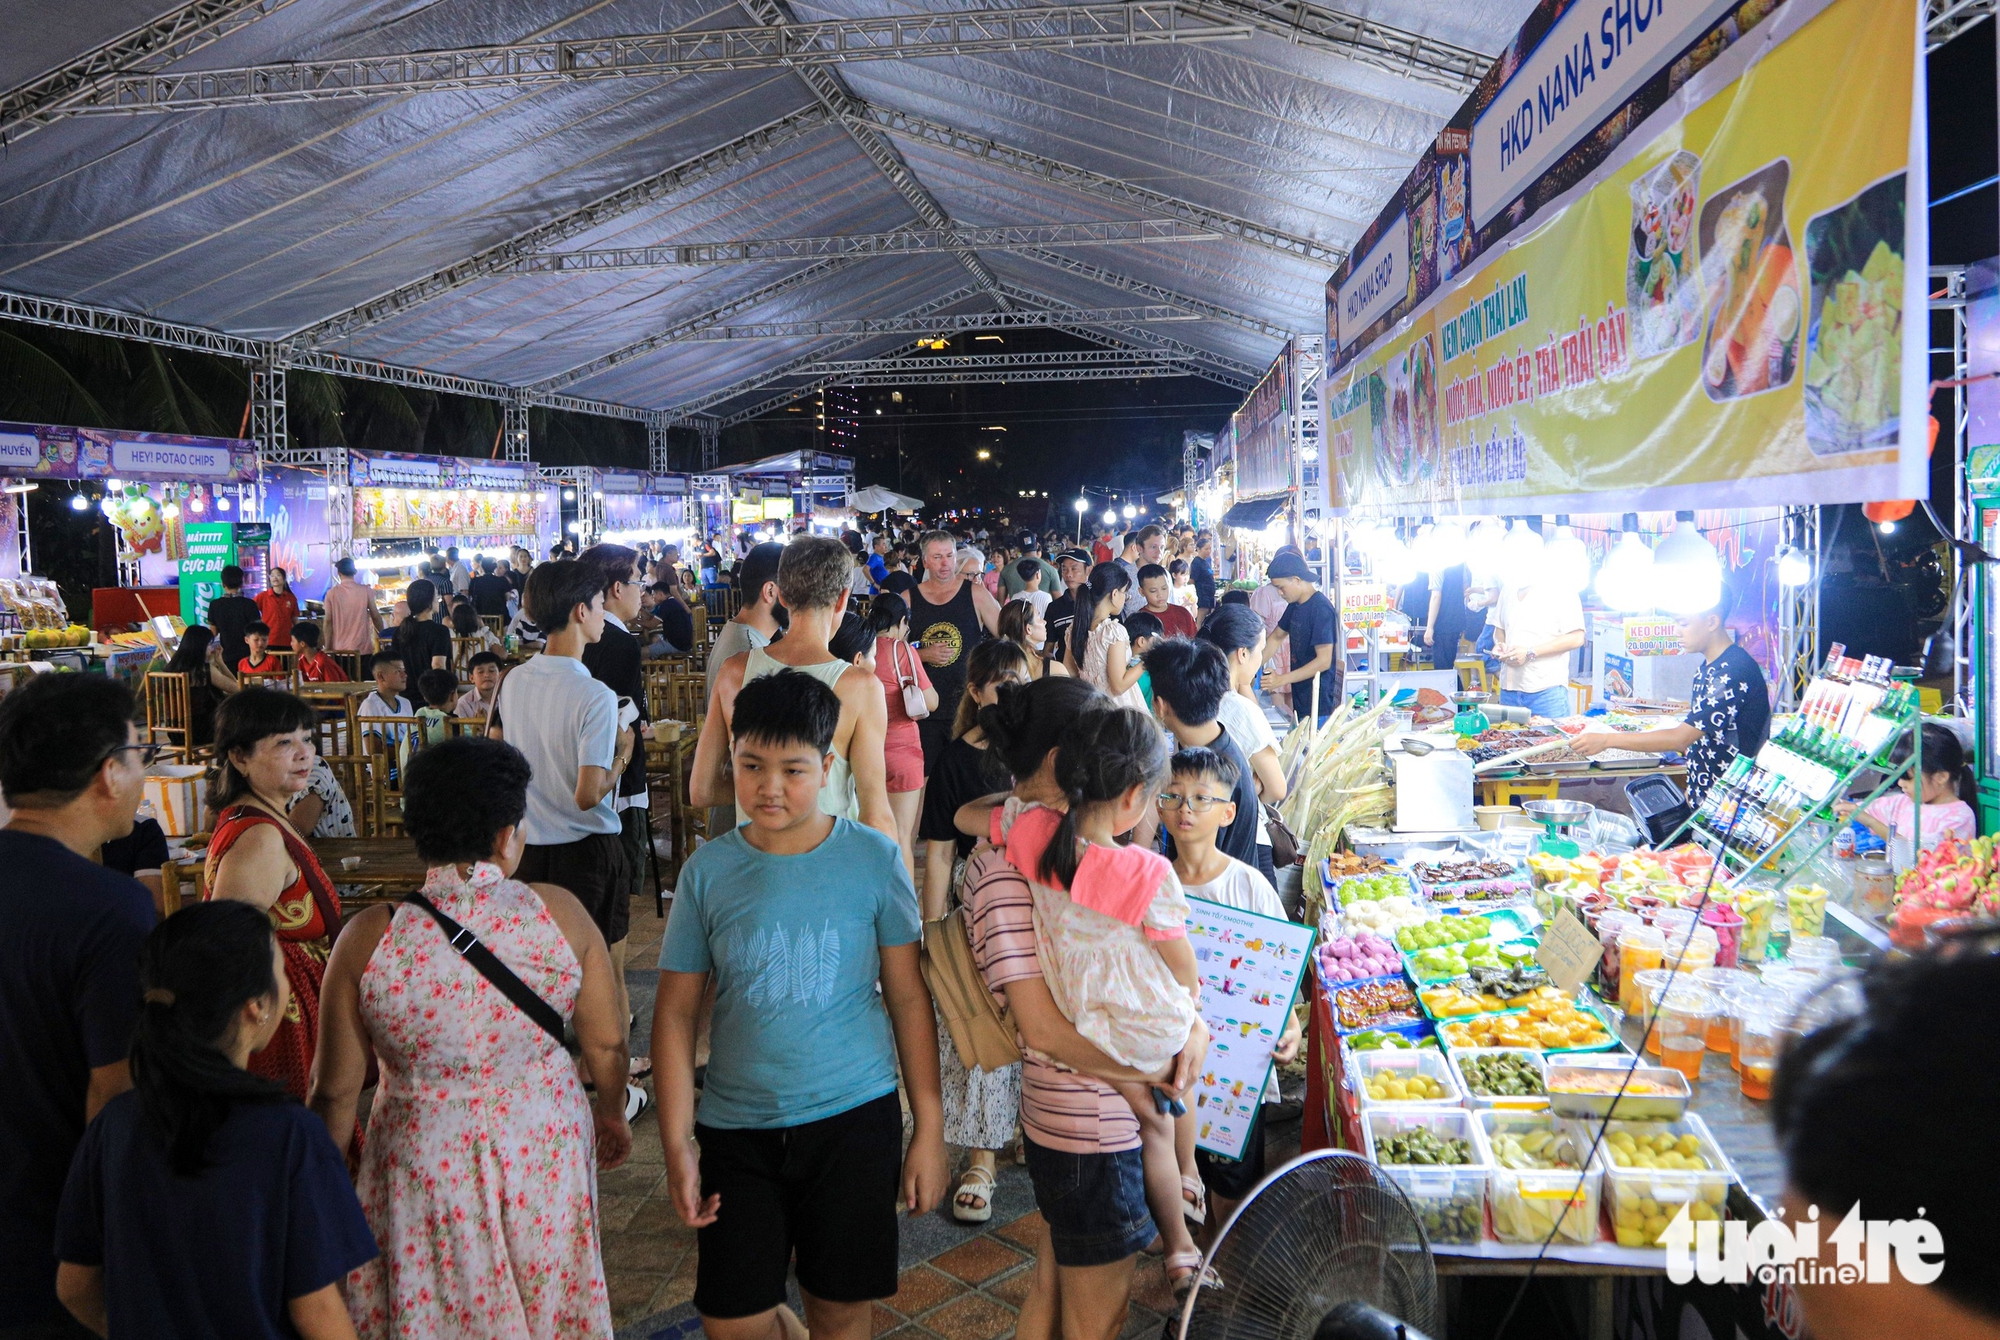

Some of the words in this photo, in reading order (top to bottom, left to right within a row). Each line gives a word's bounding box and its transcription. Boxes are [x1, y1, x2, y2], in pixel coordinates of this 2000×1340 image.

[1500, 98, 1533, 172] HKD
[1538, 31, 1595, 134] NANA
[1601, 0, 1663, 70] SHO
[1347, 290, 1358, 324] HKD
[1359, 272, 1375, 313] NANA
[1375, 252, 1392, 296] SHOP
[1442, 320, 1458, 363] KEM
[1460, 299, 1483, 355] CUỘN
[1484, 282, 1506, 339] THÁI
[1506, 274, 1529, 327] LAN
[1445, 377, 1465, 425] NƯỚC
[1487, 355, 1514, 411] NƯỚC
[1516, 348, 1534, 404] ÉP,
[1535, 333, 1560, 396] TRÀ
[1562, 319, 1595, 387] TRÁI
[1597, 305, 1629, 377] CÂY
[131, 450, 153, 463] HEY!
[156, 451, 187, 465] POTAO
[189, 454, 215, 467] CHIPS
[182, 558, 205, 576] CỰC
[1363, 593, 1382, 606] CHIP
[1195, 908, 1211, 917] SINH
[1223, 915, 1255, 929] SMOOTHIE
